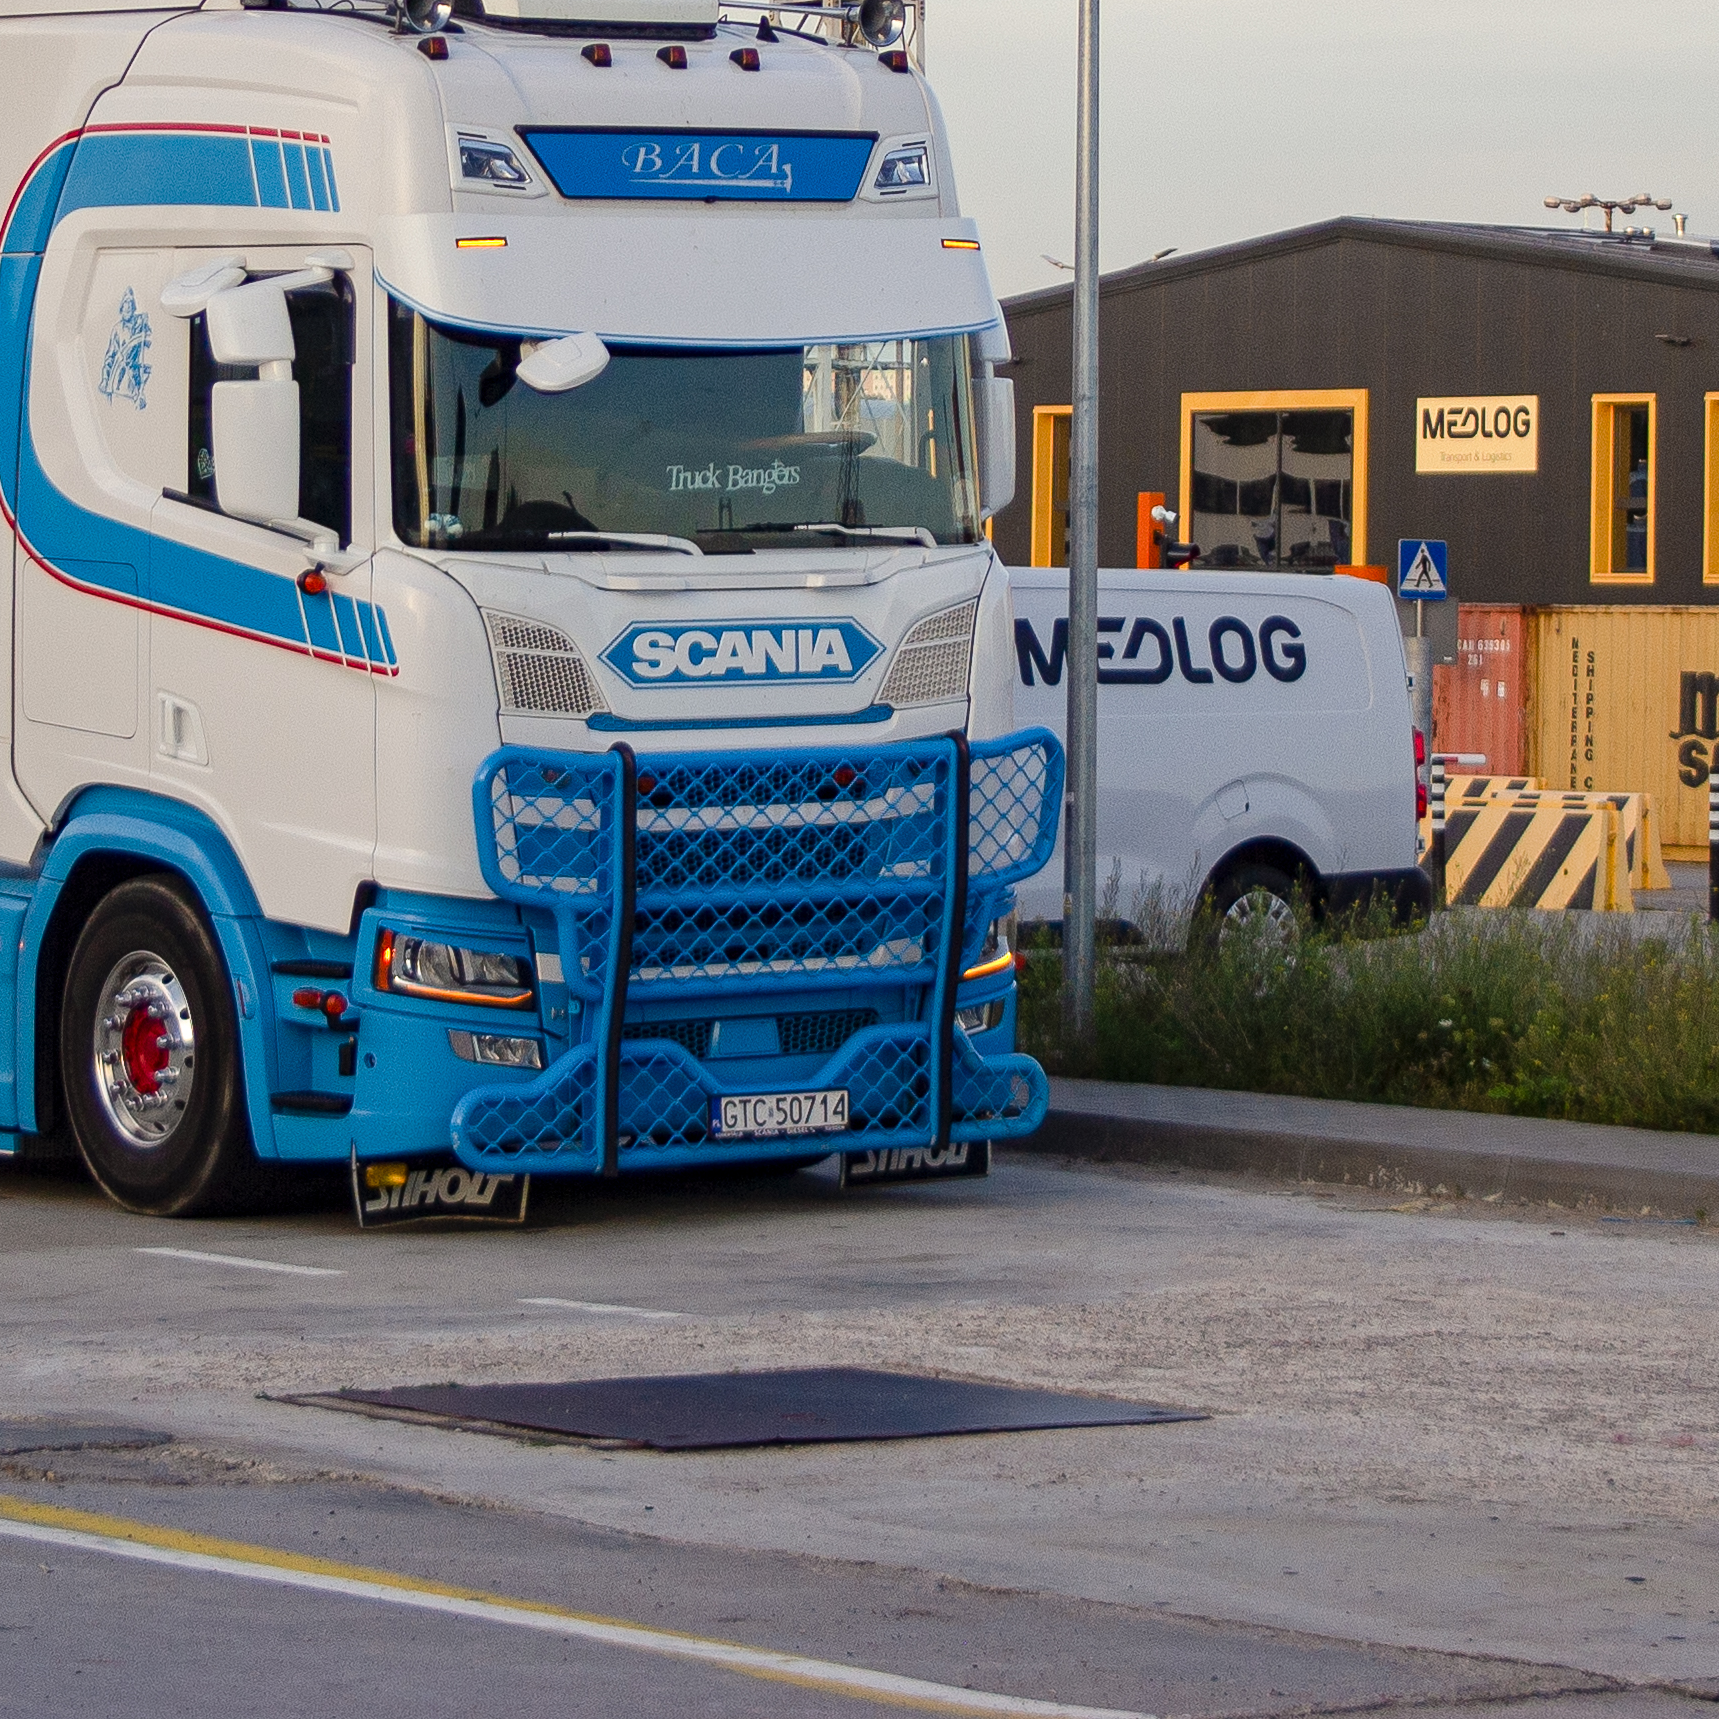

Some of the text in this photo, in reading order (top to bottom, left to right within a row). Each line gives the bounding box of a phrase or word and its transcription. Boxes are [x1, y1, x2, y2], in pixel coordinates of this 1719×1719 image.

[621, 142, 780, 179] BACA
[1422, 405, 1531, 439] MEDLOG
[1440, 451, 1512, 464] Transport & Logistics
[666, 462, 723, 491] Truck
[632, 628, 854, 678] SCANIA
[1014, 615, 1307, 686] MEDLOG
[1584, 651, 1595, 761] SHIPPING
[723, 1093, 846, 1128] GTC 50714
